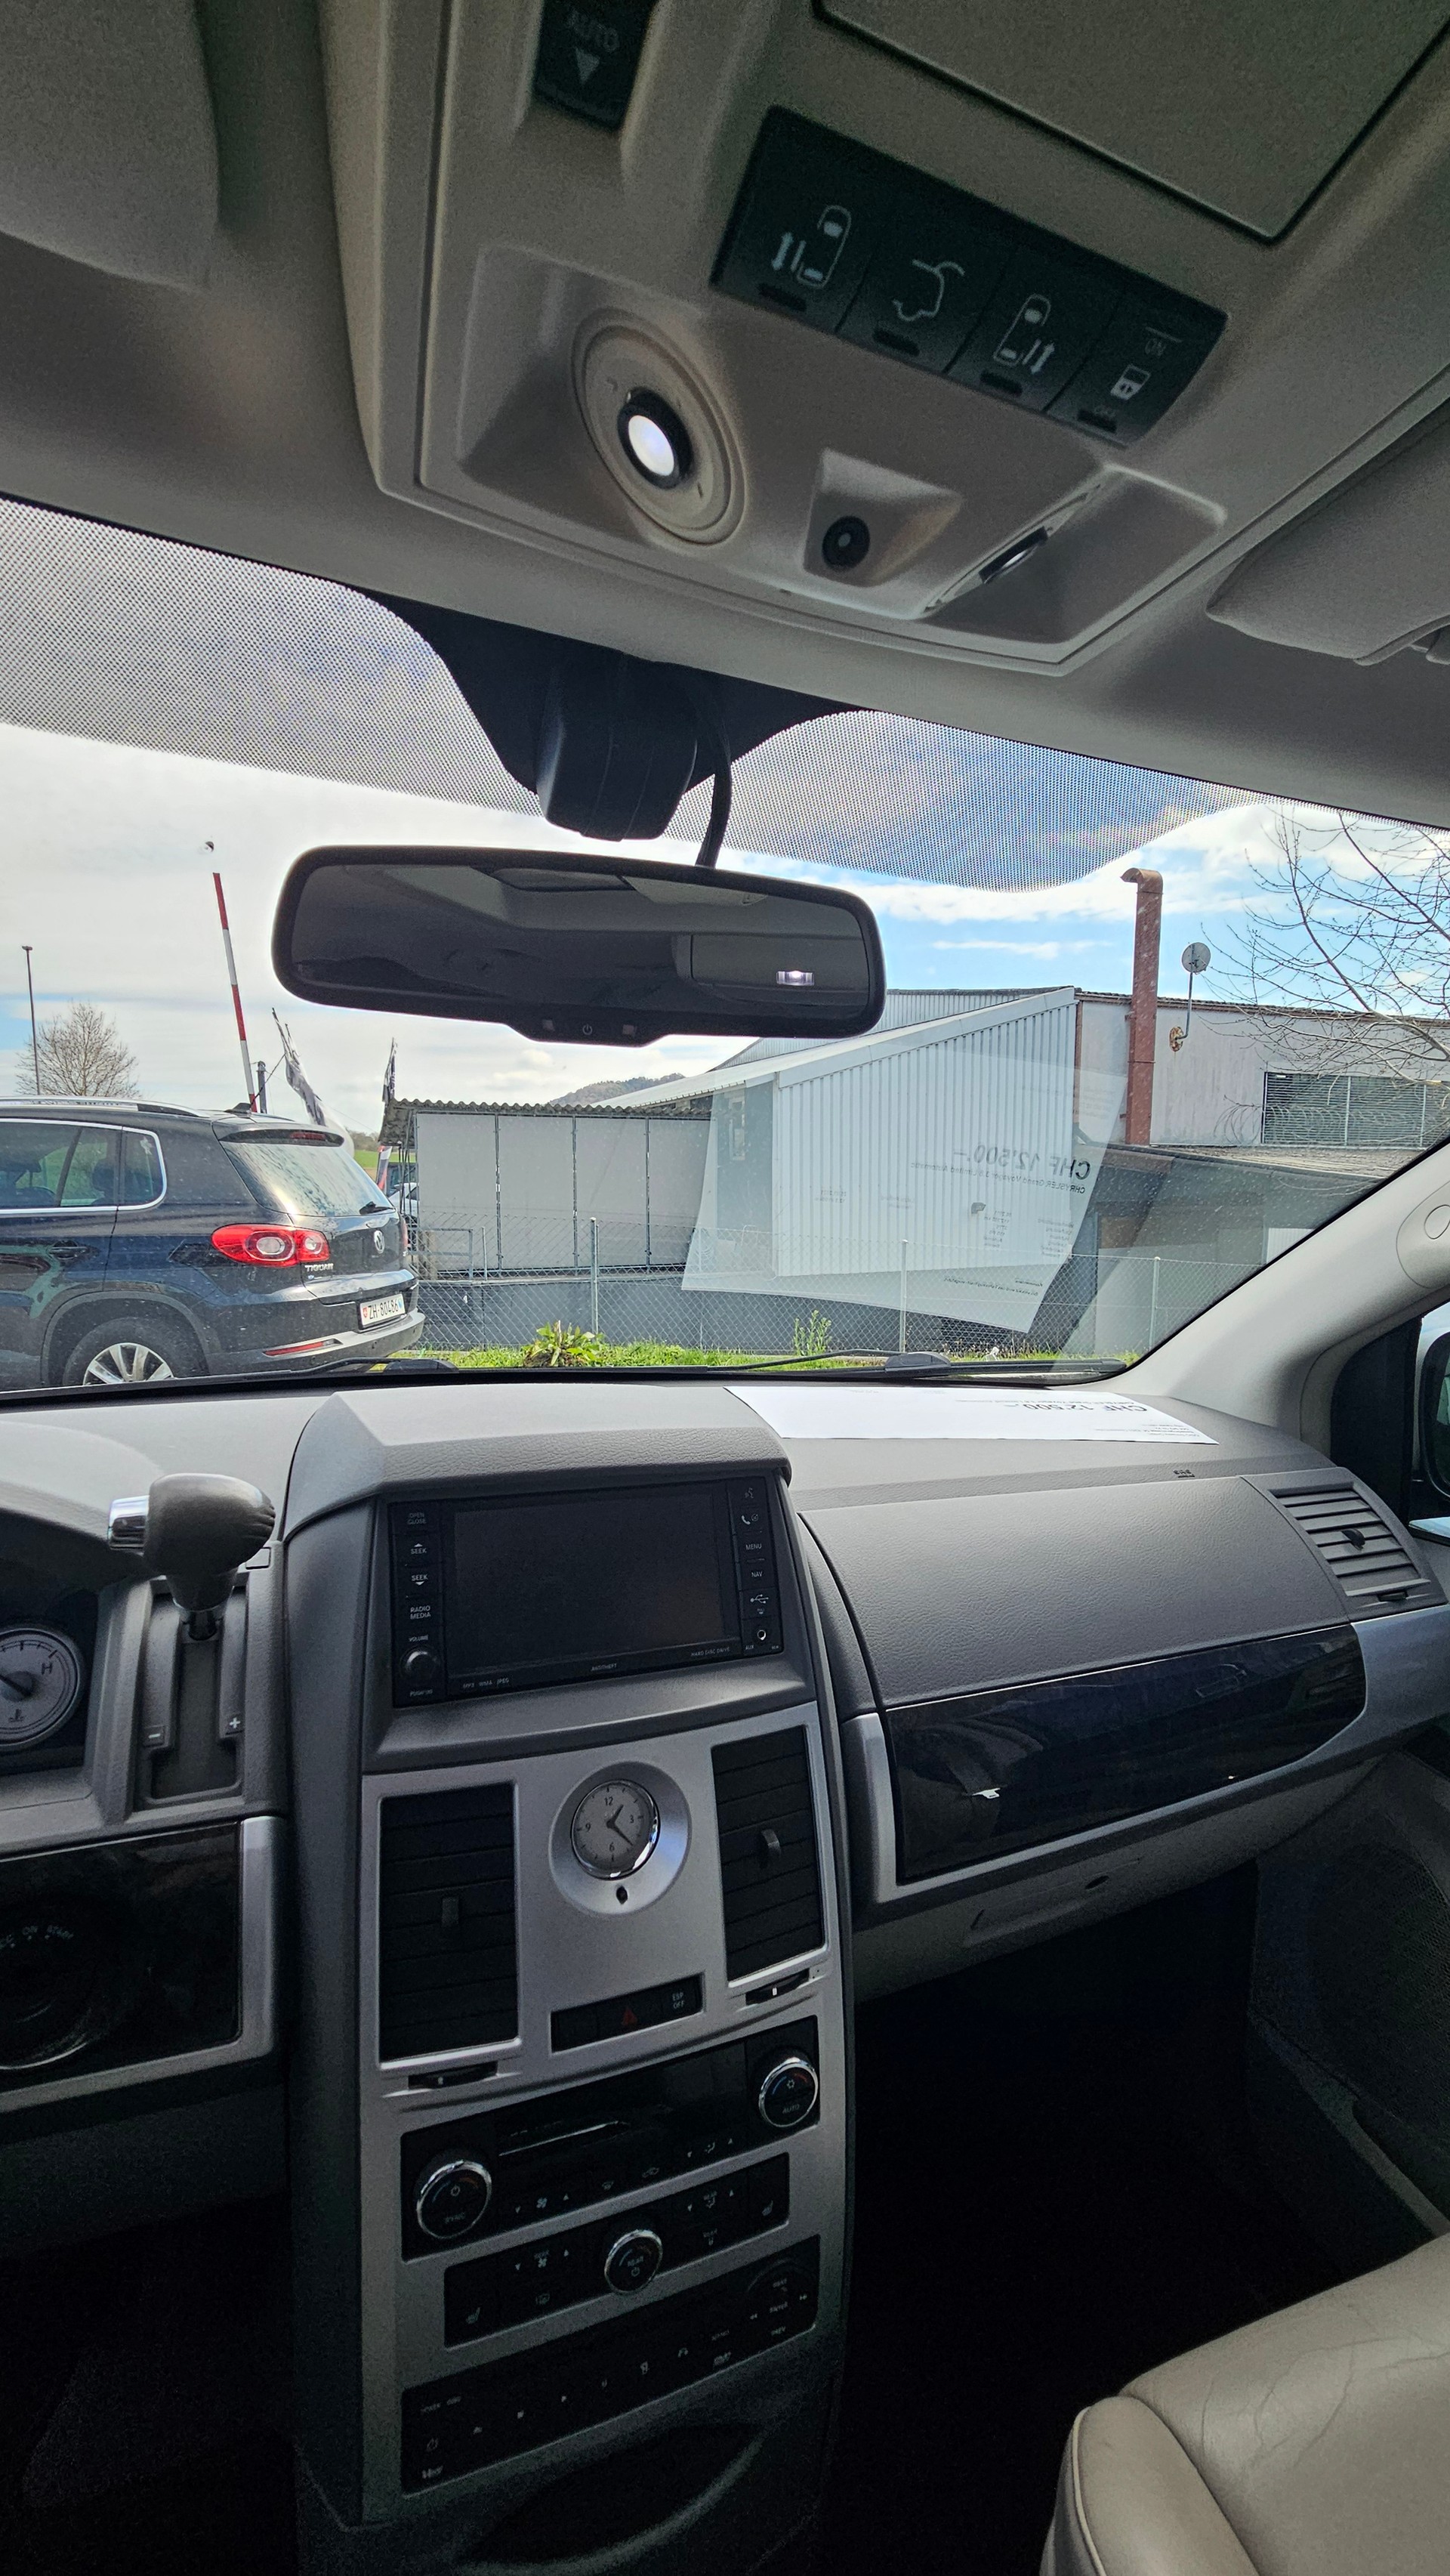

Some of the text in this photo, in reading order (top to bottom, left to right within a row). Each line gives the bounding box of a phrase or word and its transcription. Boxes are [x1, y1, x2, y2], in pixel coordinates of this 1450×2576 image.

[1145, 338, 1167, 358] ON
[304, 1263, 334, 1271] TIGUAN
[42, 1663, 53, 1675] H
[604, 1796, 613, 1806] 12
[630, 1815, 634, 1824] 3
[585, 1823, 591, 1833] 9
[609, 1842, 615, 1852] 6
[672, 1991, 684, 2001] ESP
[673, 2000, 685, 2009] OFF
[782, 2104, 800, 2114] AUTO
